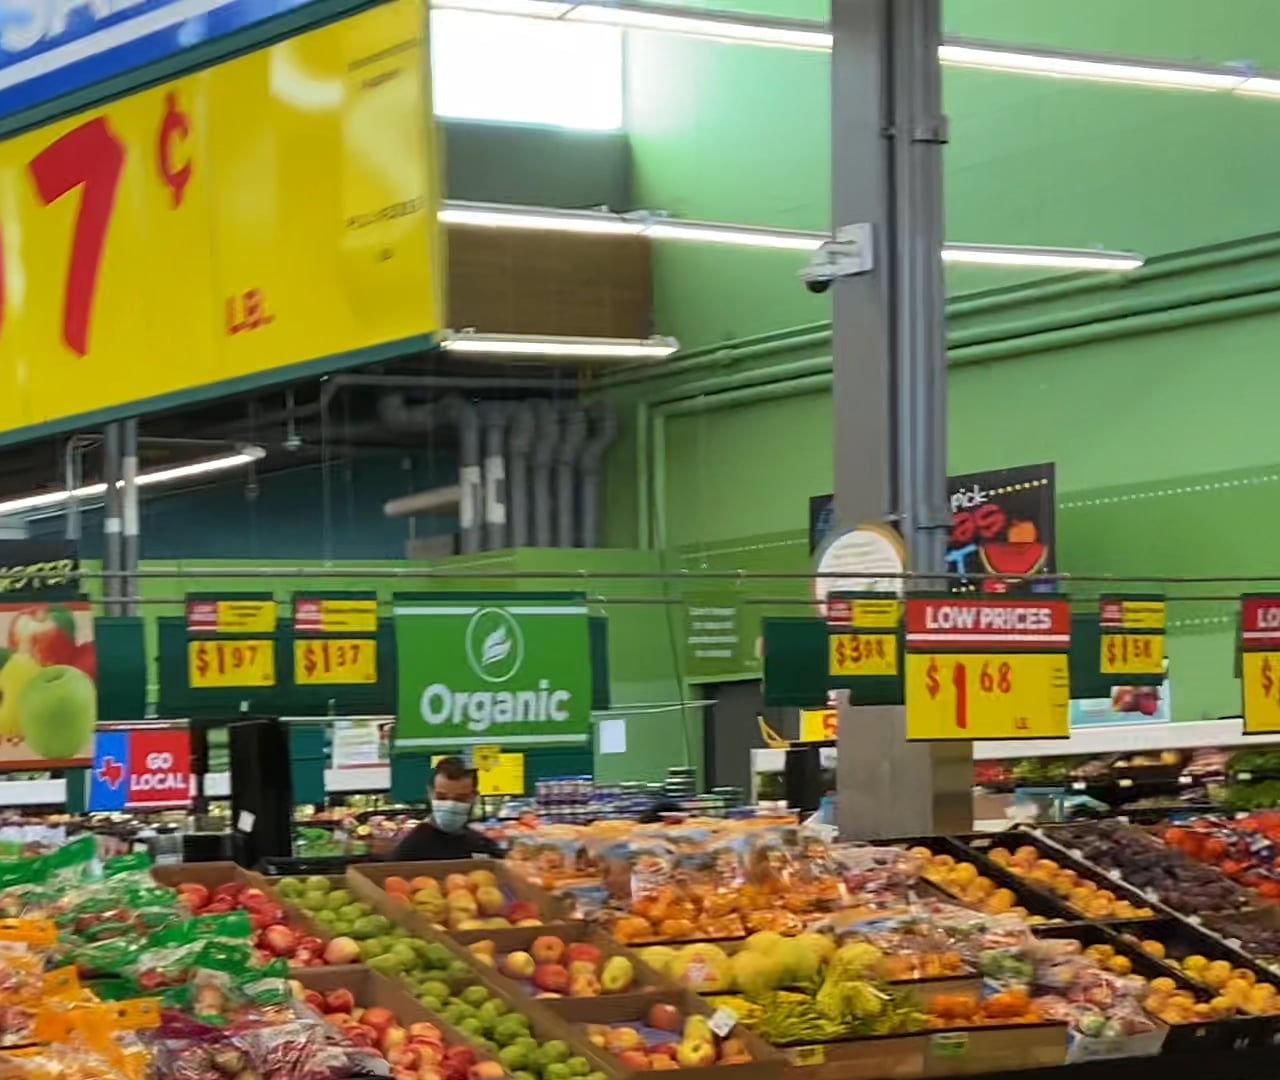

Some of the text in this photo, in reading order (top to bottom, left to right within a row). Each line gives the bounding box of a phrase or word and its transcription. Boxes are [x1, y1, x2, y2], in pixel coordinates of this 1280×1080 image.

[926, 607, 1053, 630] LOW PRICES
[1257, 607, 1280, 630] LO
[420, 680, 571, 731] Organic
[145, 752, 174, 769] GO
[131, 772, 188, 791] LOCAL
